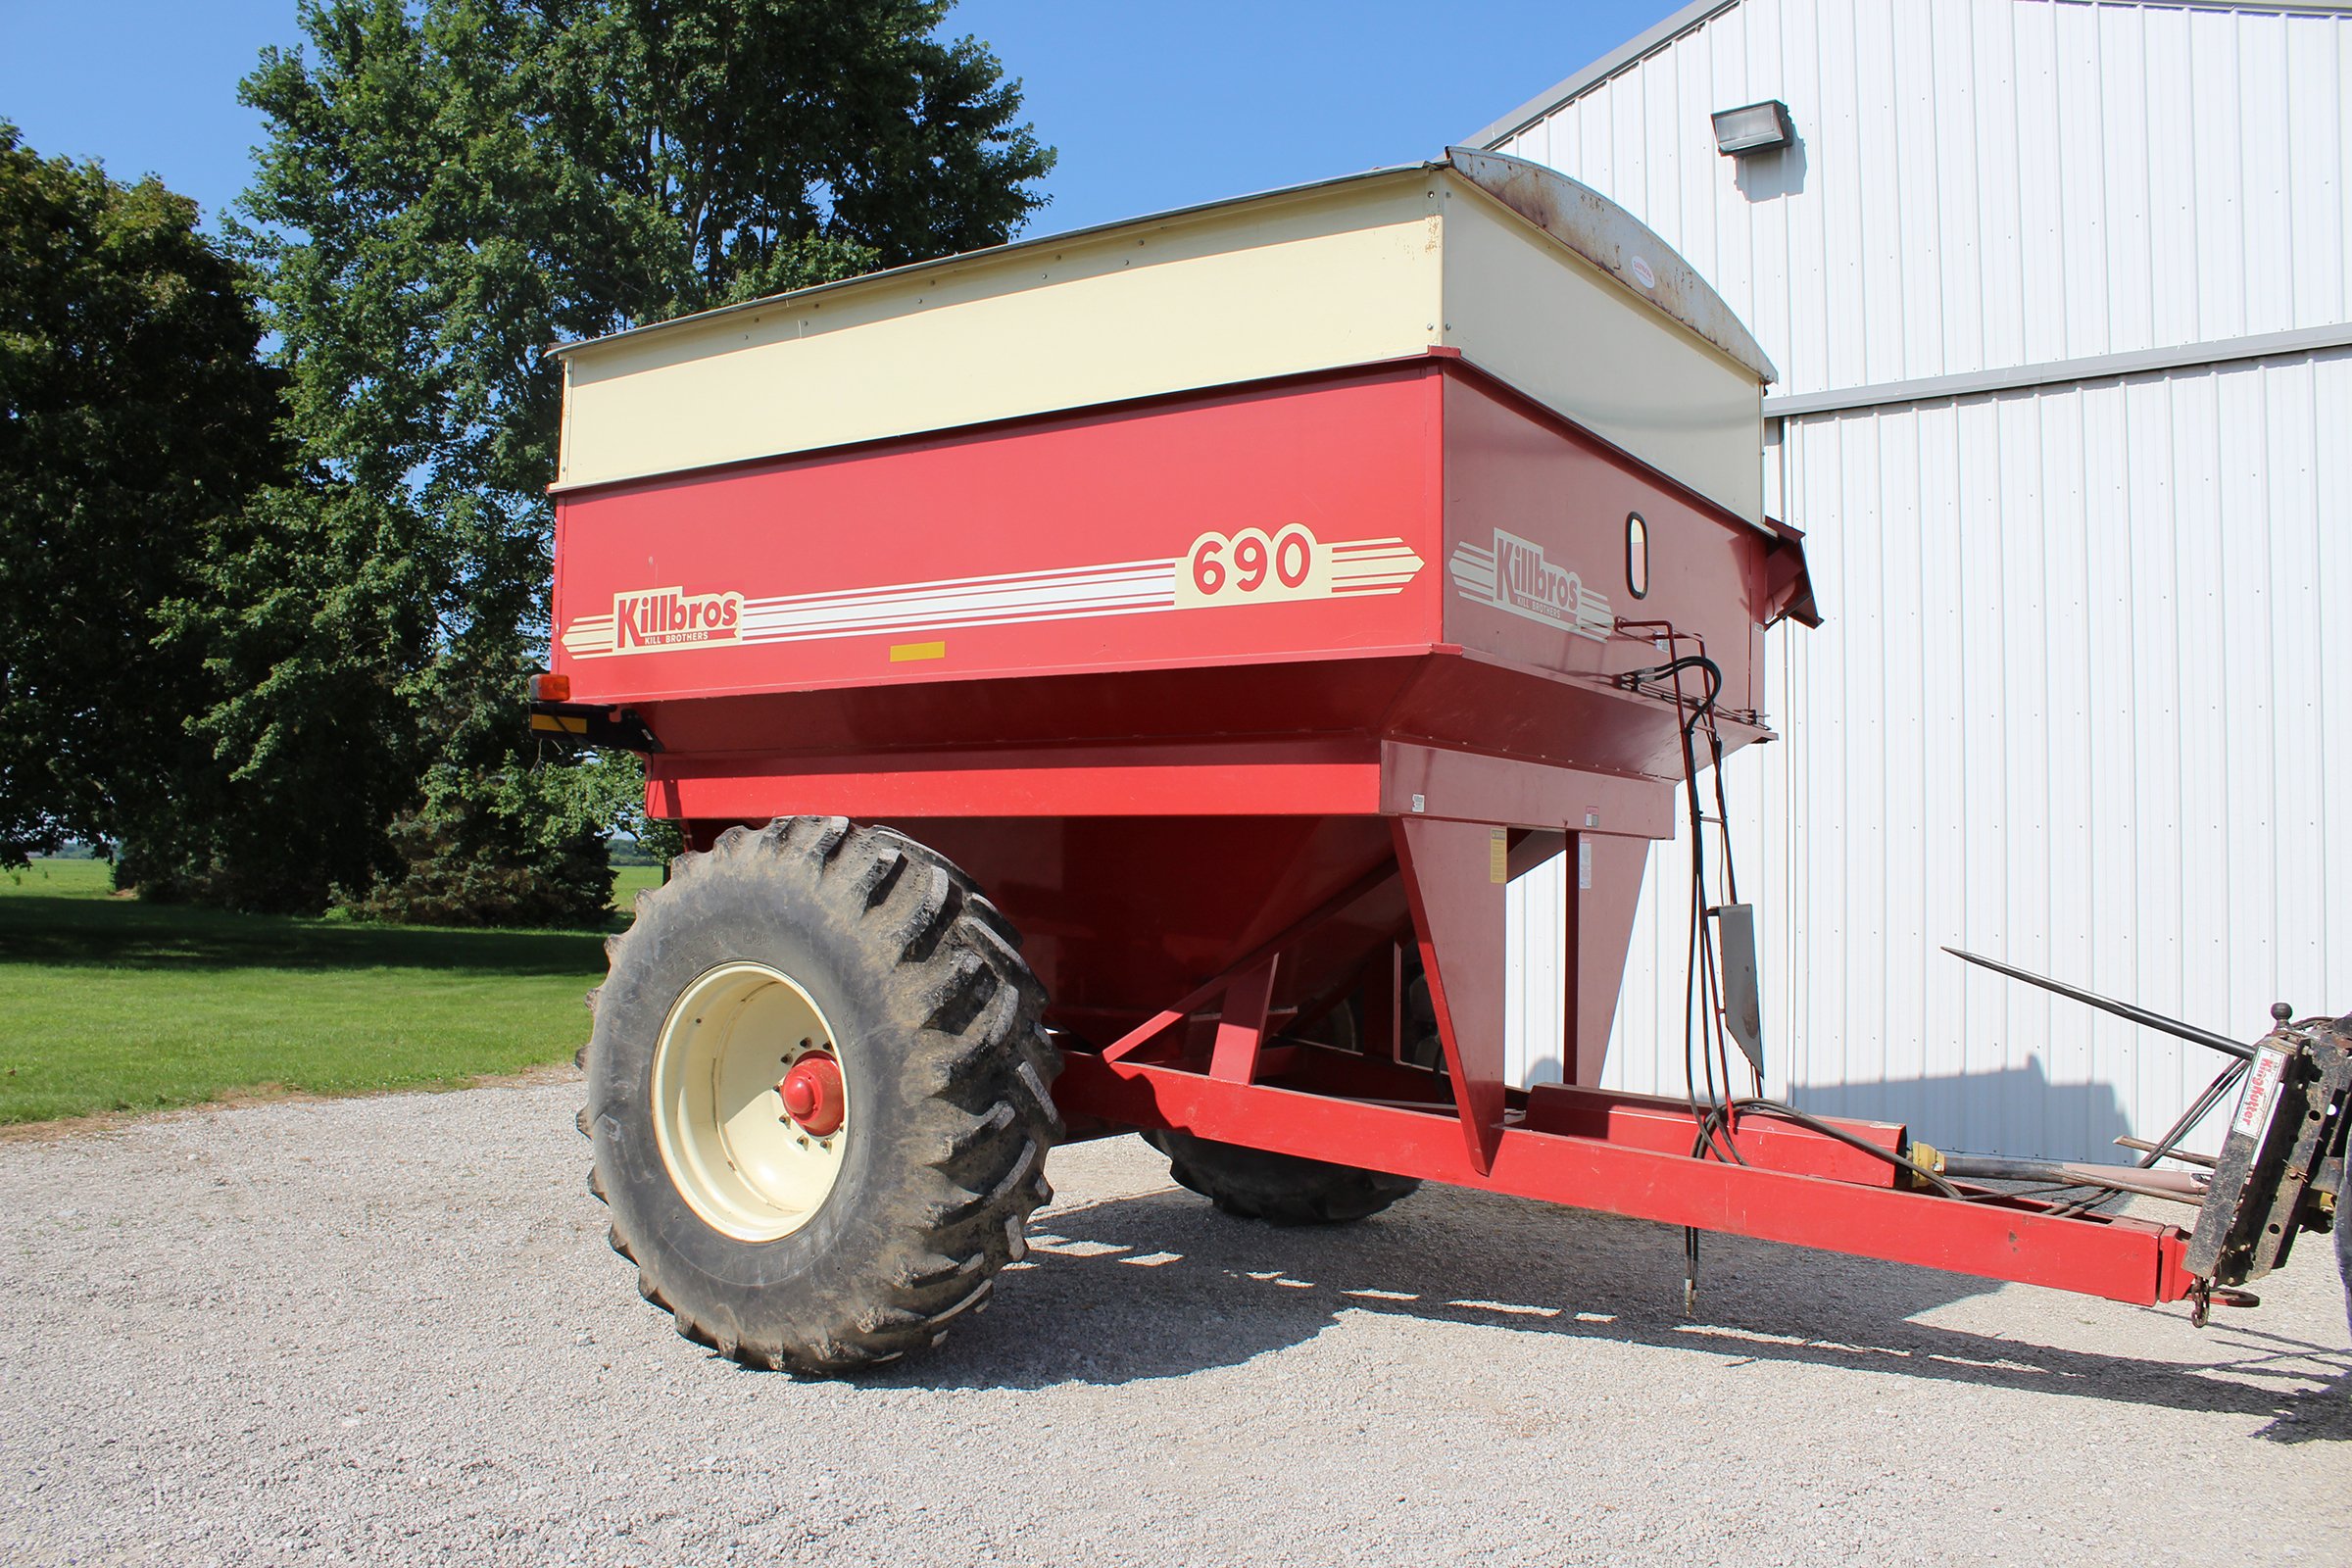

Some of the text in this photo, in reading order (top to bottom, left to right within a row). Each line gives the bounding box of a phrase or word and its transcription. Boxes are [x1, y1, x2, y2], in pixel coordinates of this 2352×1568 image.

[1193, 532, 1311, 596] 690
[1496, 537, 1578, 612] Killbros
[617, 594, 738, 649] Killbros
[1517, 596, 1561, 619] KILL BROTHERS
[644, 631, 709, 645] KILL BROTHERS
